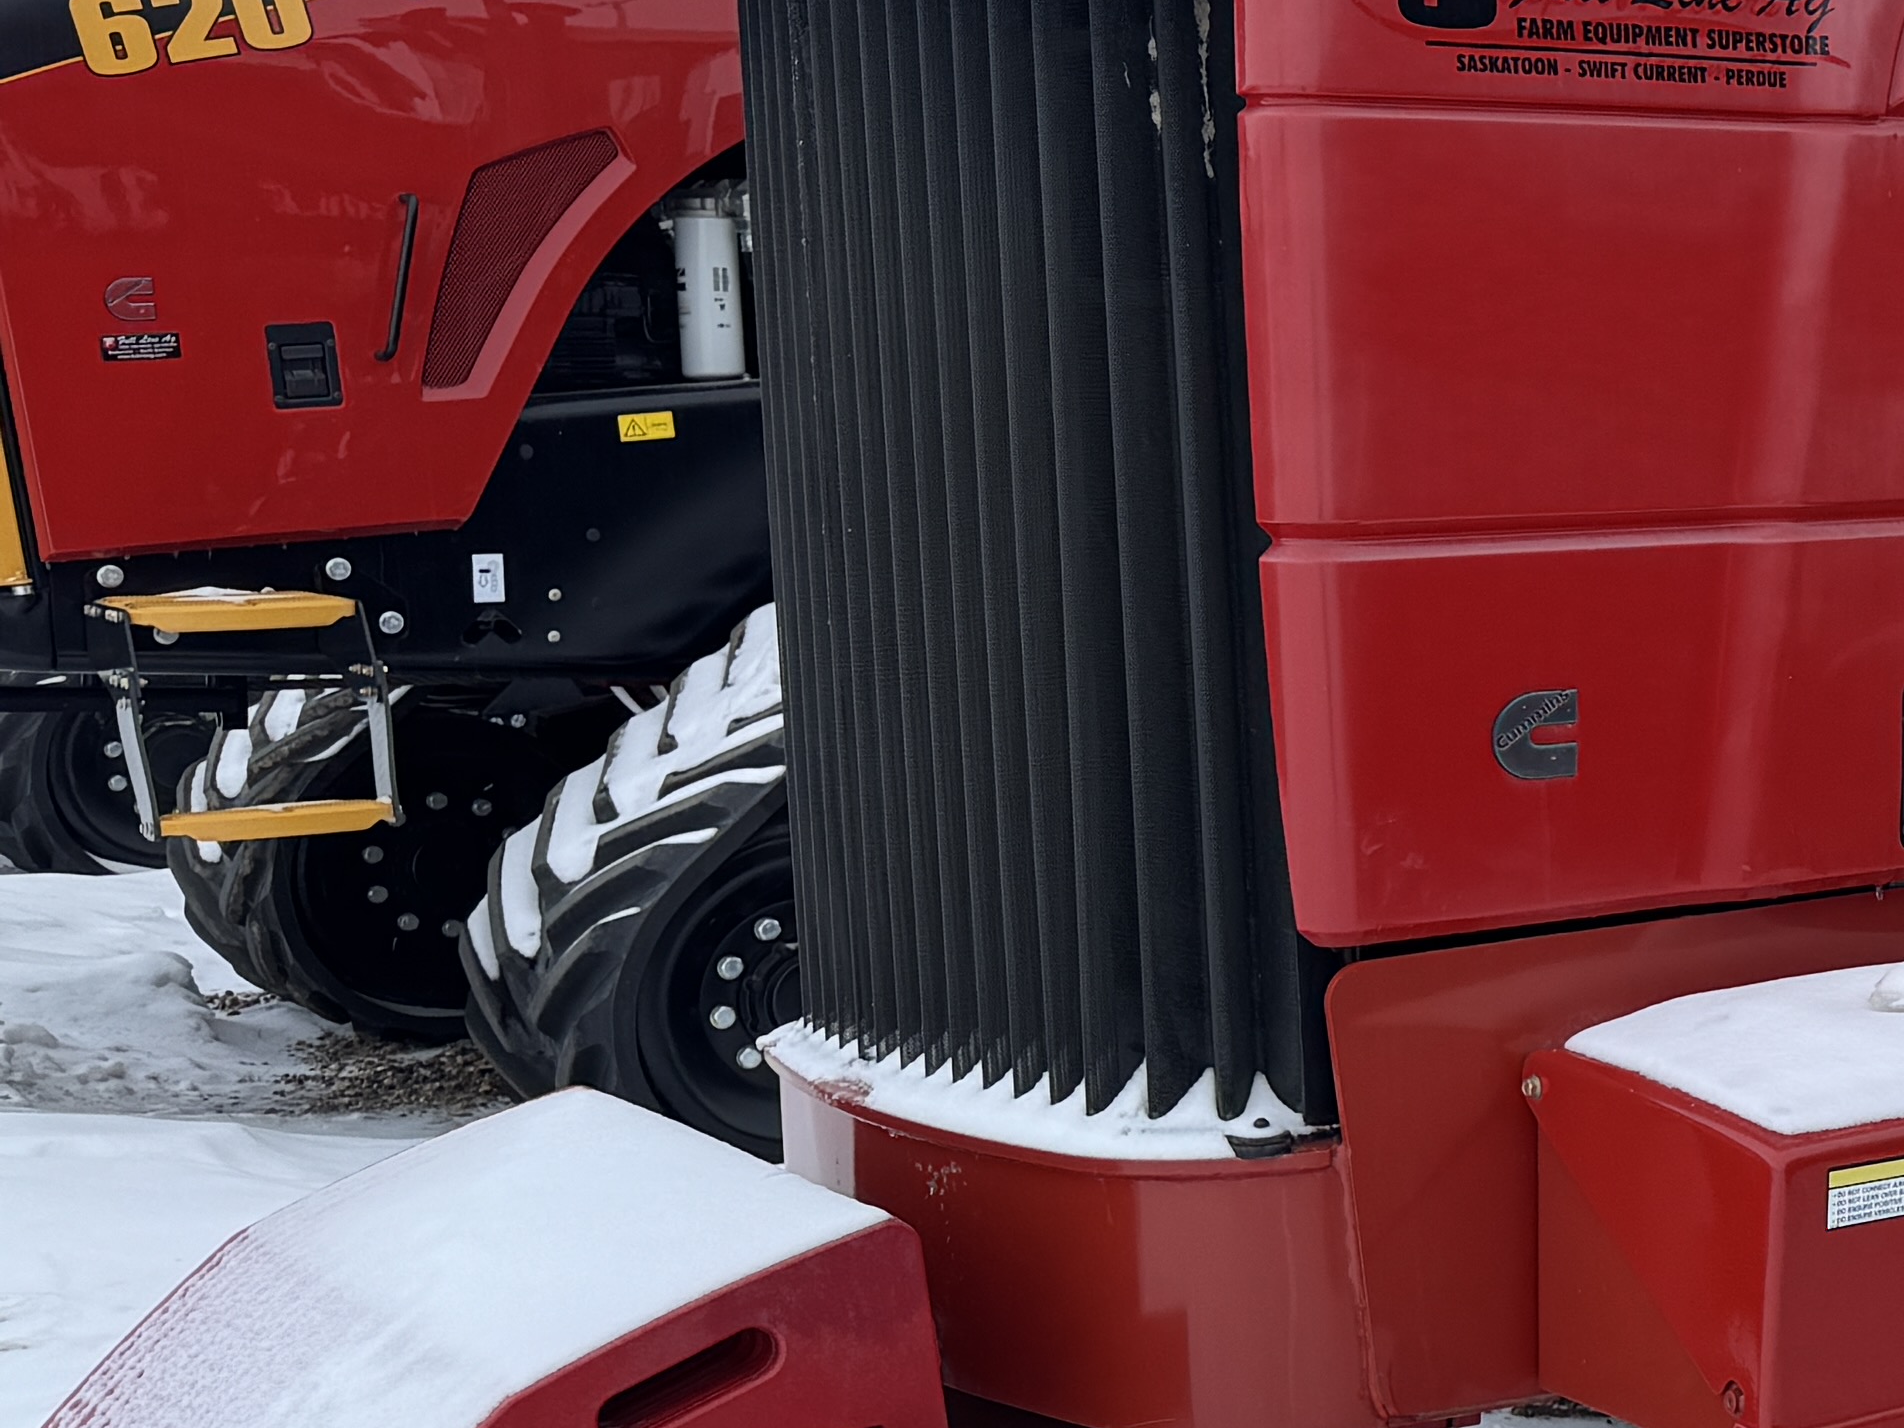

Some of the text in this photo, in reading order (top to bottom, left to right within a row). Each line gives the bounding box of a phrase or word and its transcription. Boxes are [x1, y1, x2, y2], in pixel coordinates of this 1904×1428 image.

[1516, 17, 1830, 56] FARM EQUIPMENT SUPERSTORE
[1456, 54, 1559, 76] SASKATOON
[1578, 59, 1629, 80] SWIFT
[1633, 62, 1708, 85] CURRENT
[1725, 67, 1787, 89] PERDUE
[1496, 691, 1571, 750] Cummins
